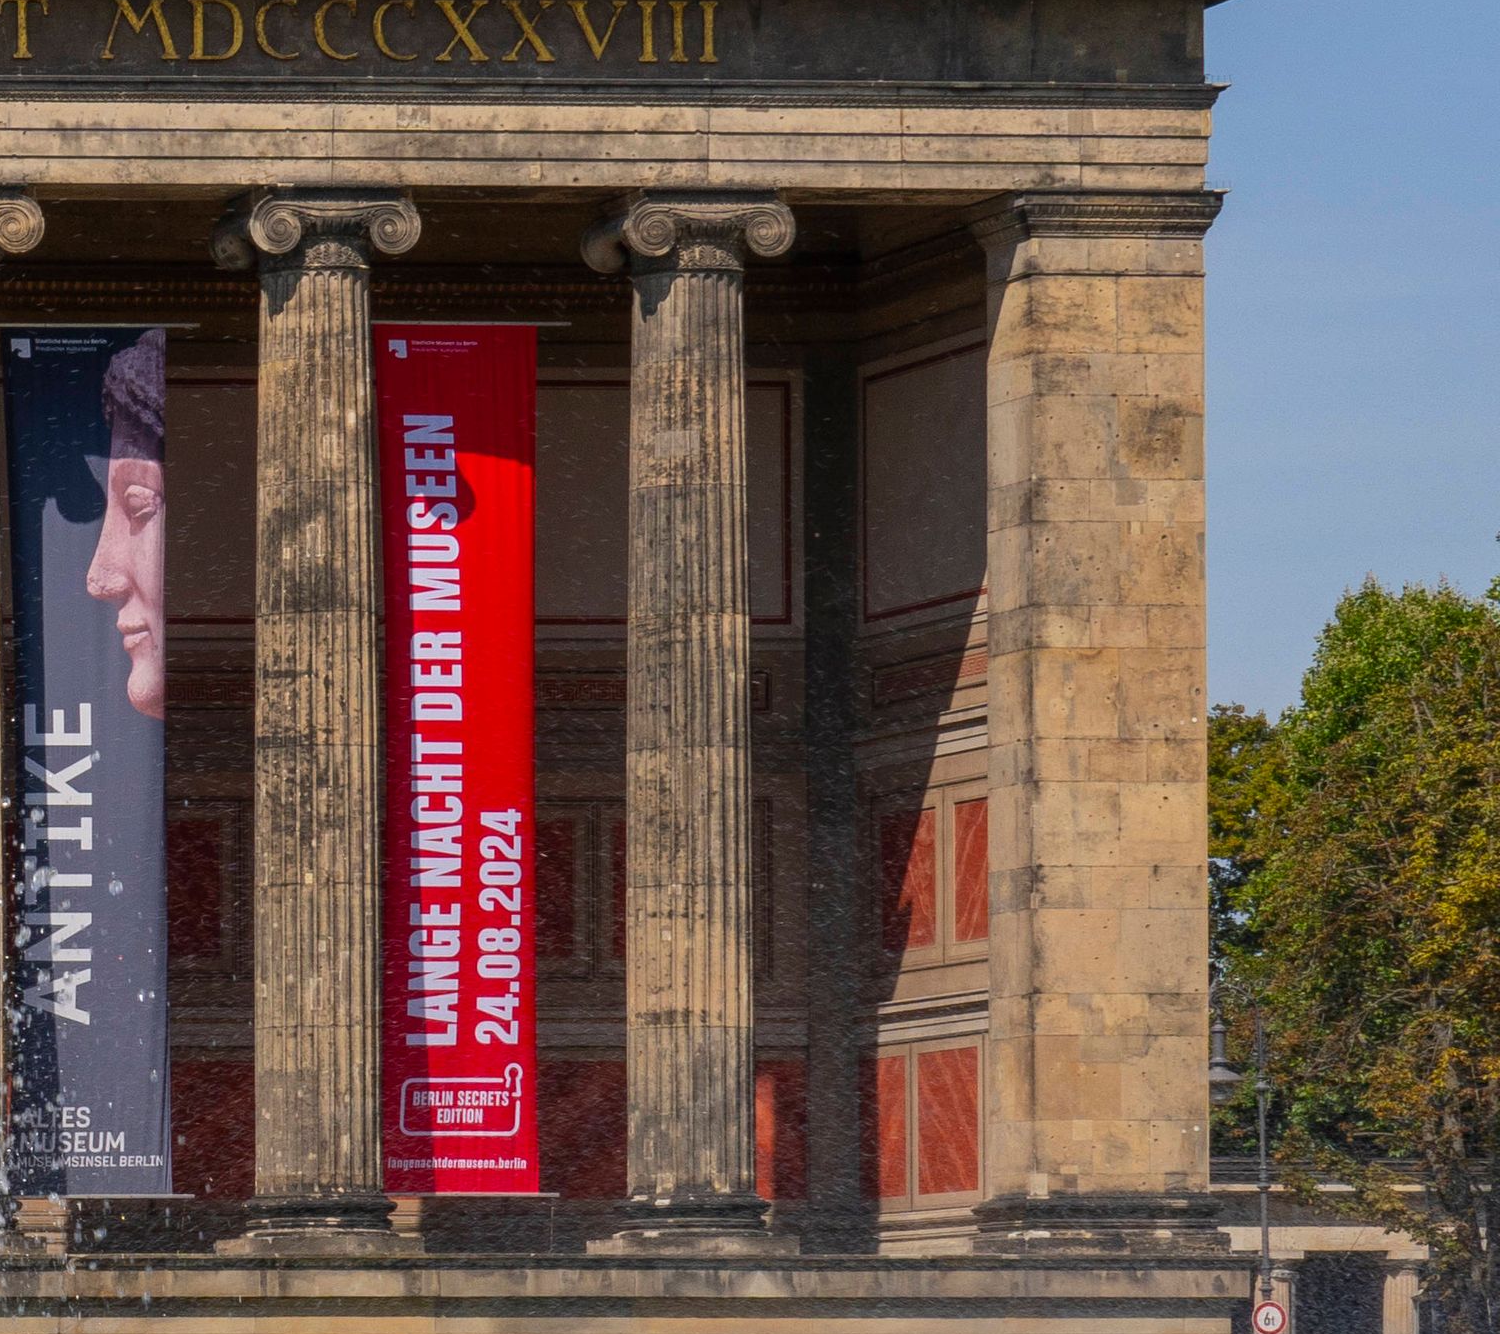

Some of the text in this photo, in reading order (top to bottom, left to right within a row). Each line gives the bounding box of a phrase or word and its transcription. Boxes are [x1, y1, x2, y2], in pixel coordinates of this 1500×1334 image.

[403, 414, 461, 612] MUSEEN
[410, 631, 463, 721] DER
[410, 733, 463, 888] NACHT
[22, 702, 93, 1026] ANTIKE
[474, 808, 522, 1045] 24.08.2024
[405, 903, 461, 1046] LANGE
[20, 1106, 91, 1128] ALTES
[412, 1090, 509, 1106] BERLIN SECRETS
[436, 1108, 484, 1124] EDITION
[19, 1131, 125, 1153] MUSEUM
[119, 1154, 164, 1167] BERLIN
[388, 1157, 527, 1171] langenachtdermuseen.berlin
